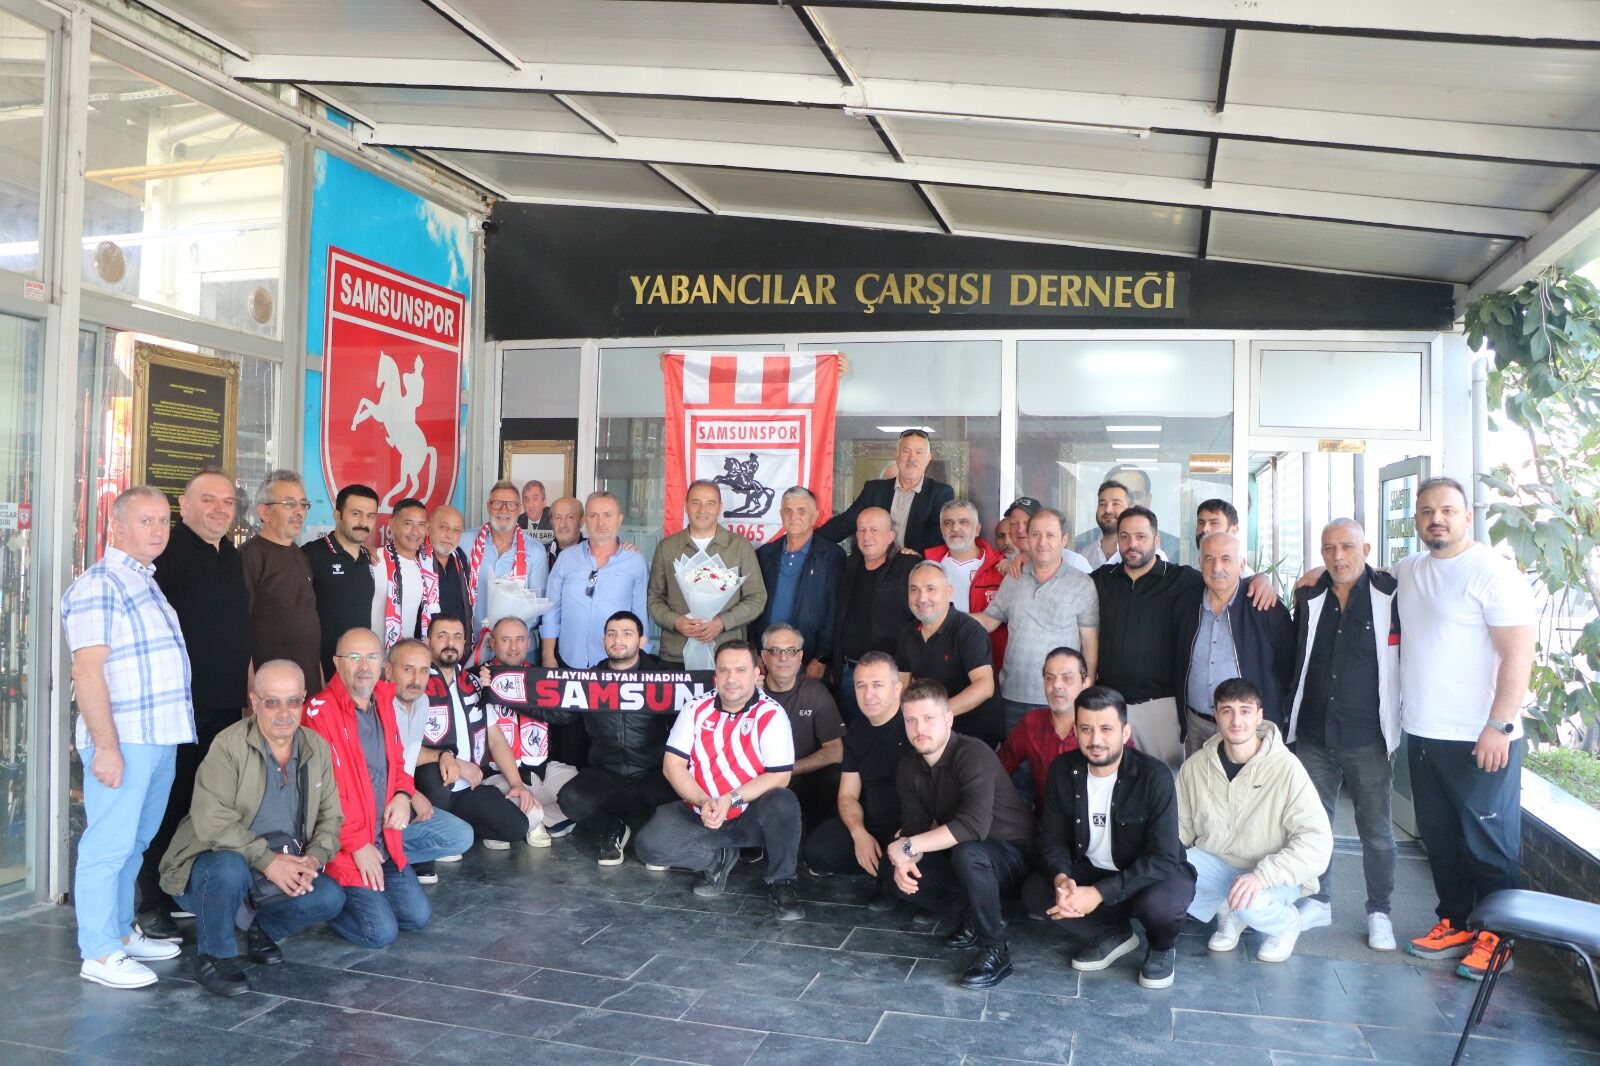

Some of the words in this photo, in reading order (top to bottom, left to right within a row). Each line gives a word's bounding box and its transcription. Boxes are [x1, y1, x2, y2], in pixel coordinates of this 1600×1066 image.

[630, 274, 837, 305] YABANCILAR
[855, 273, 991, 314] ÇARŞISI
[1009, 271, 1176, 309] DERNEĞİ
[340, 272, 455, 338] SAMSUNSPOR
[698, 426, 798, 440] SAMSUNSPOR
[728, 524, 765, 541] 1965
[546, 670, 598, 681] ALAYINA
[535, 680, 704, 712] SAMSUN
